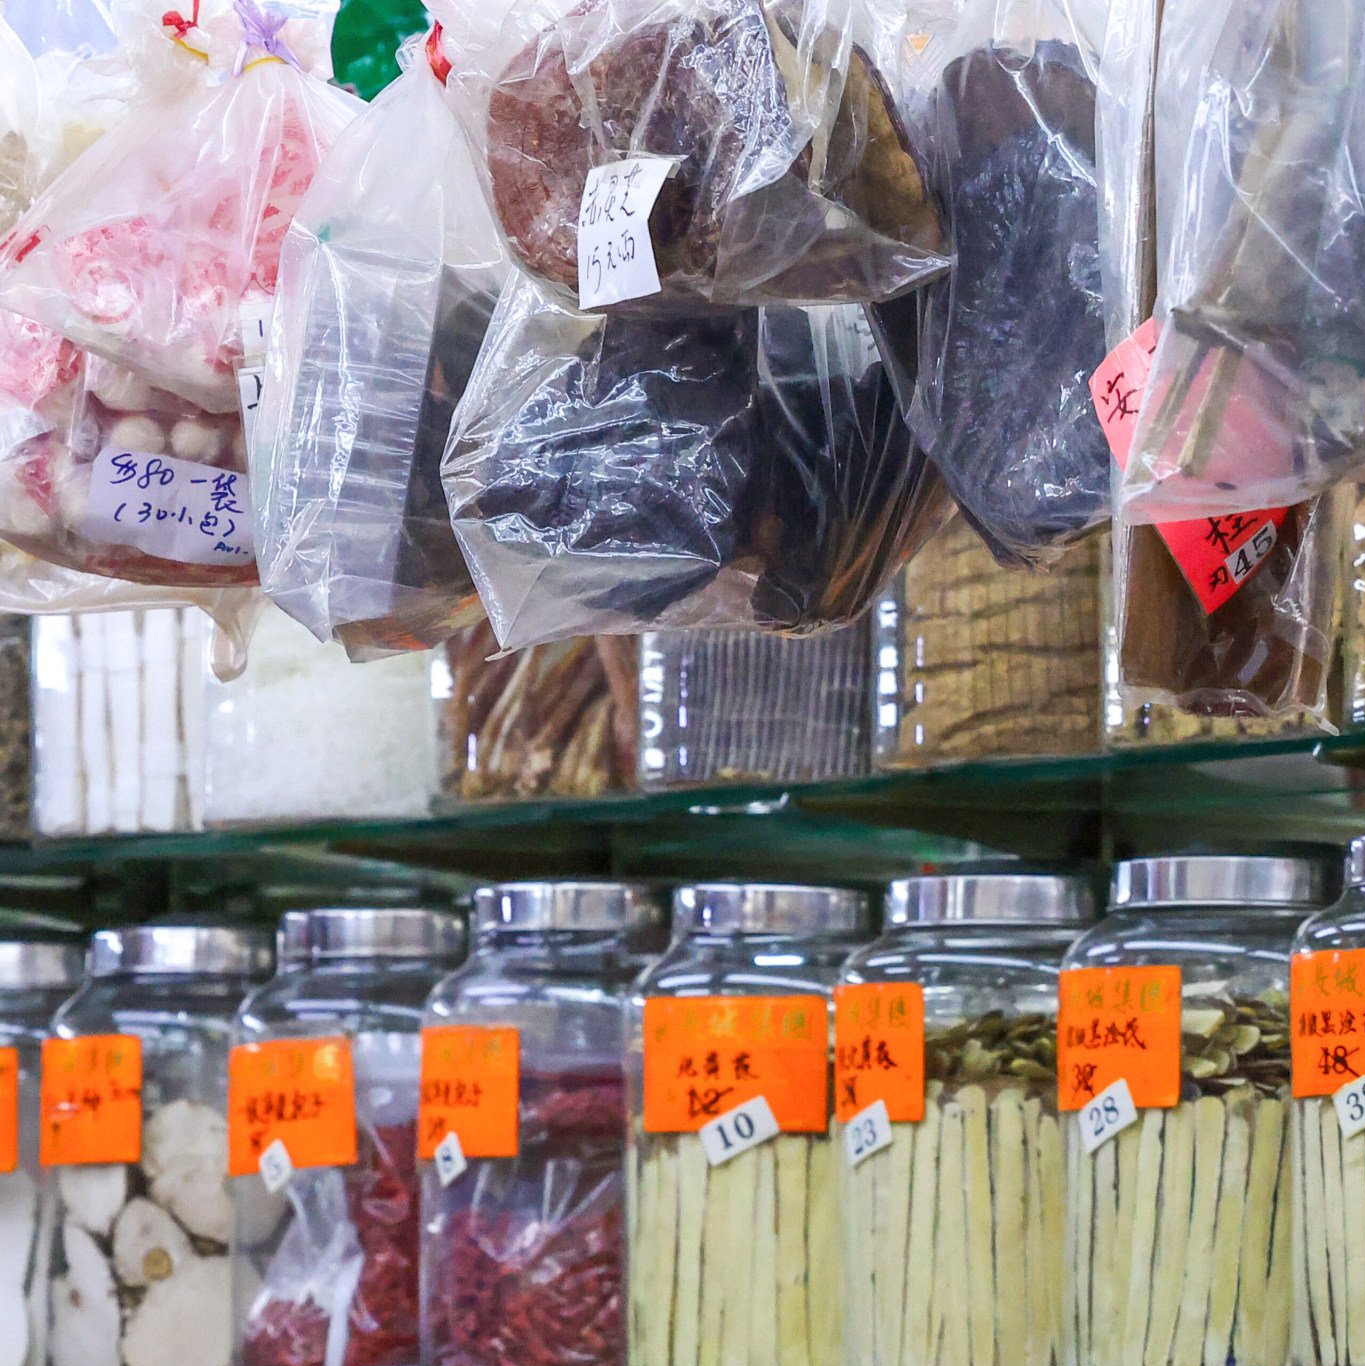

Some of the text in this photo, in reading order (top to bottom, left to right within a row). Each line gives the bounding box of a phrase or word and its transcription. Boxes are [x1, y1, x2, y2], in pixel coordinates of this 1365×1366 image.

[1233, 526, 1274, 576] 45
[716, 1112, 755, 1151] 10
[1089, 1095, 1120, 1137] 28
